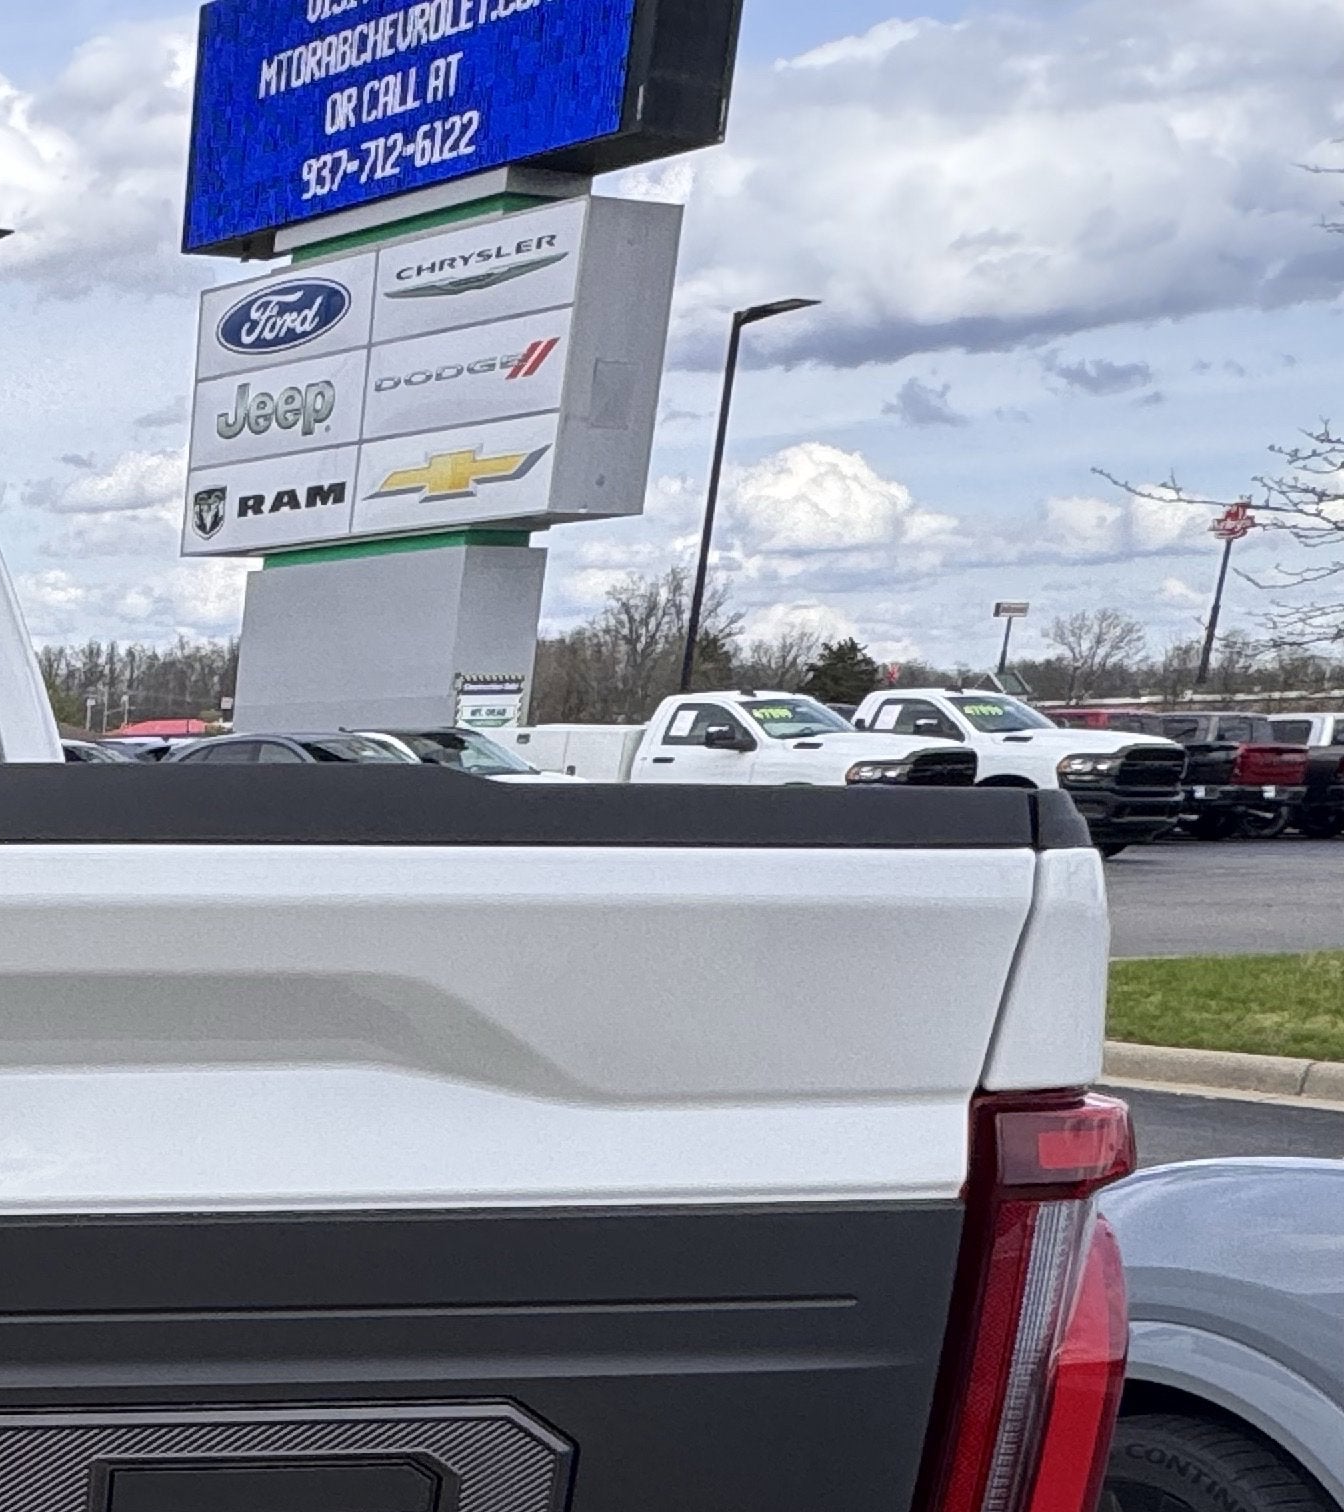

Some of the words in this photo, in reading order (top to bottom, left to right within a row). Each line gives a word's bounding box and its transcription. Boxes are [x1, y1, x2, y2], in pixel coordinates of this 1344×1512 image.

[258, 0, 552, 99] MTORABCHEVROLET.
[324, 87, 359, 136] OR
[362, 67, 421, 124] CALL
[426, 51, 463, 104] AT
[300, 110, 480, 201] 937-712-6122
[395, 234, 557, 281] CHRYSLER
[240, 289, 325, 345] Ford
[374, 353, 522, 392] DODGE
[216, 380, 336, 440] Jeep
[237, 481, 347, 519] RAM
